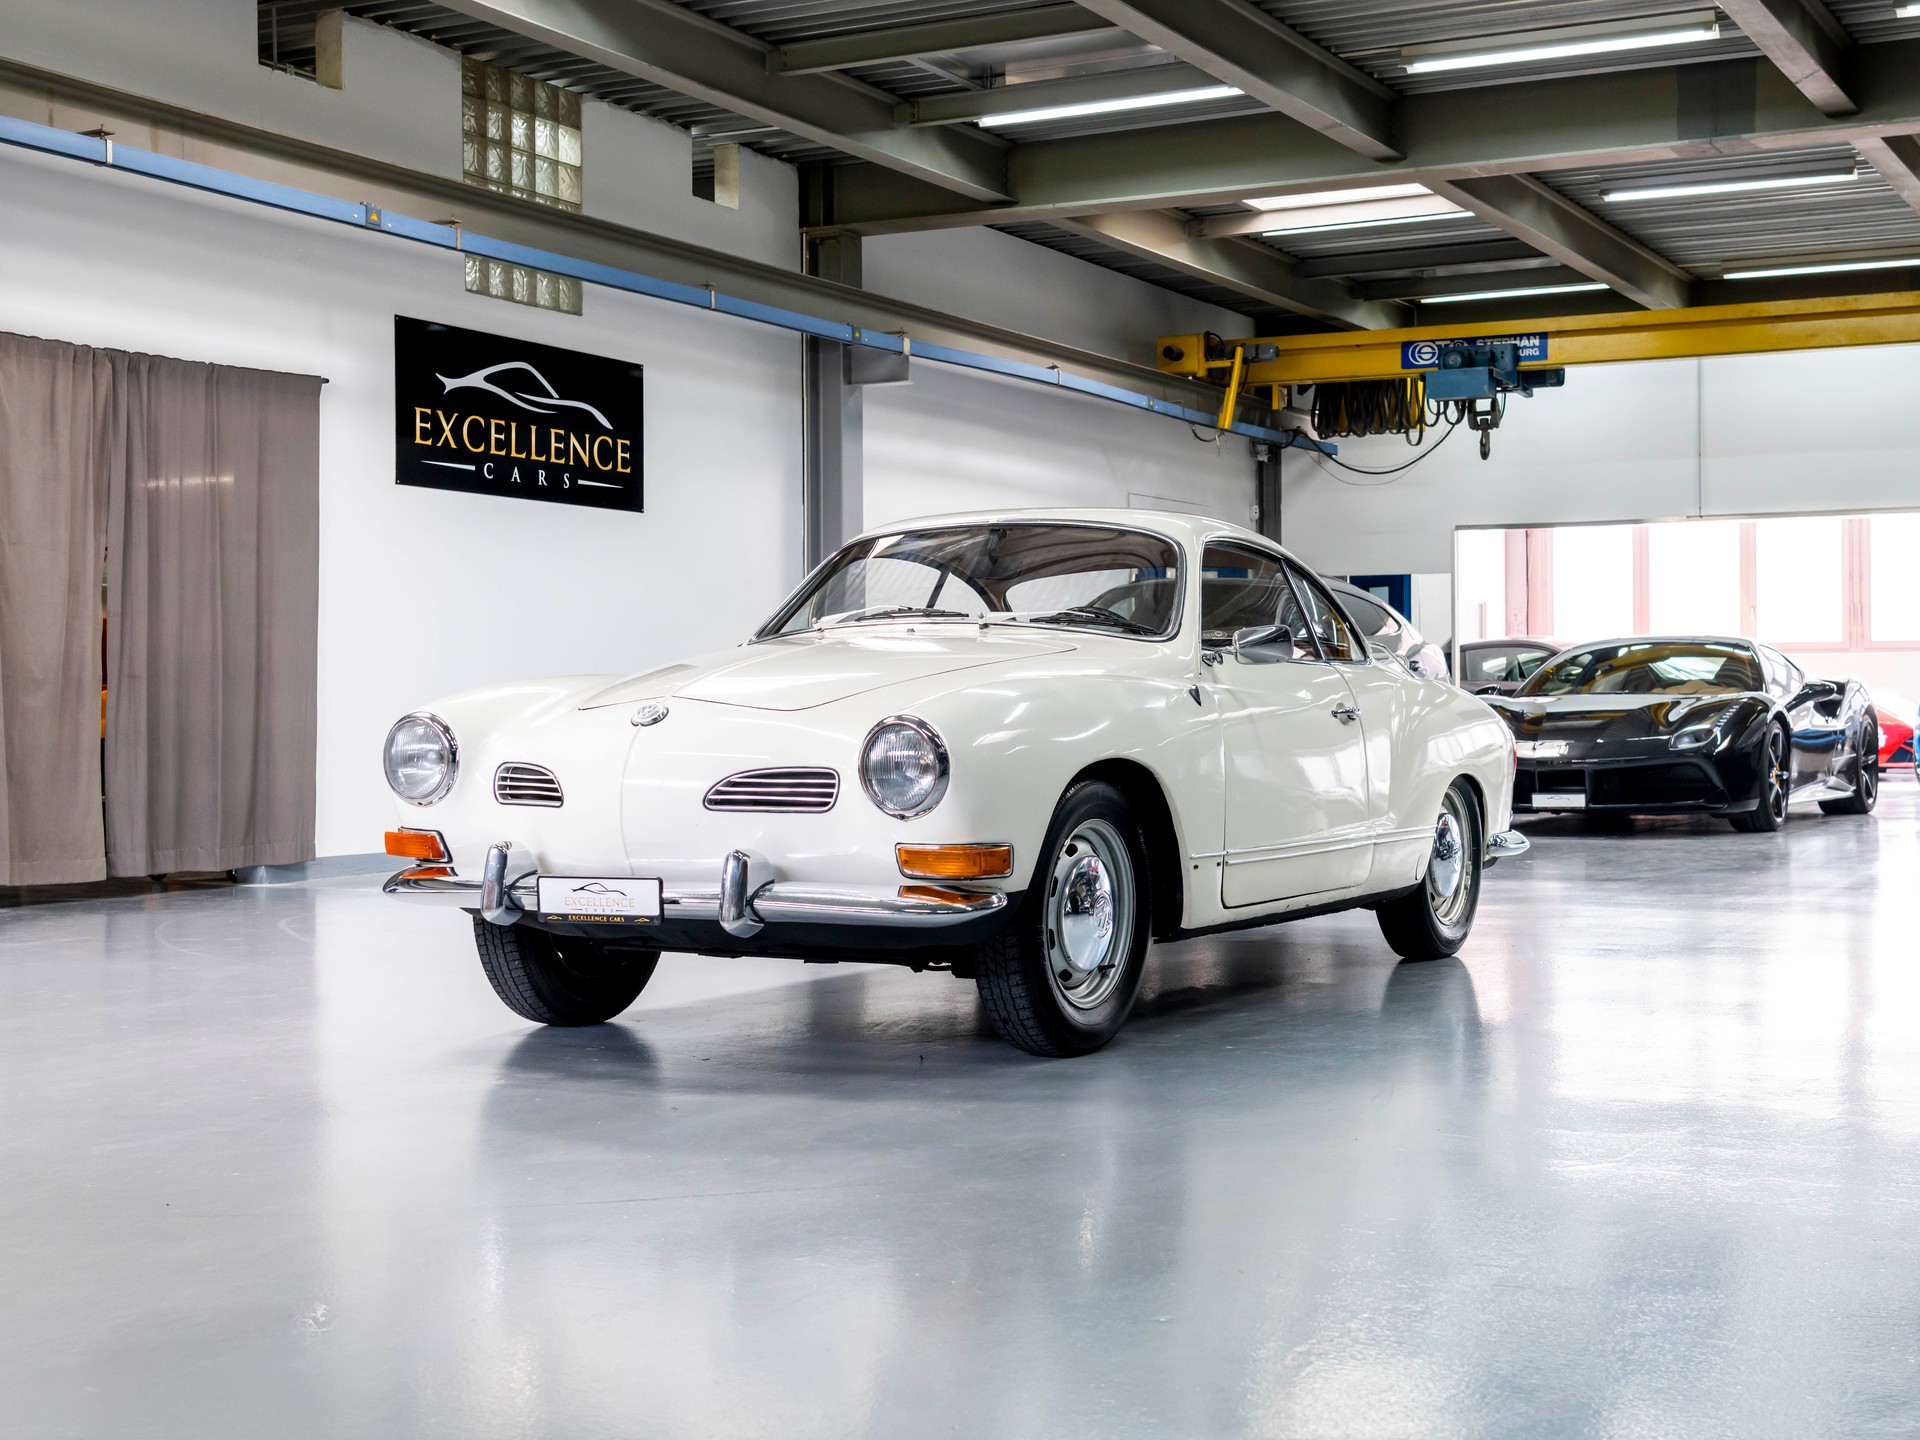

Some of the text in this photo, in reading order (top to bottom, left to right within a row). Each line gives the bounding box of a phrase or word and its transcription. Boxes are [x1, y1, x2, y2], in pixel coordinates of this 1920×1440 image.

[414, 406, 631, 473] EXCELLENCE
[483, 462, 570, 489] CARS
[564, 896, 635, 908] EXCELLENCE
[568, 914, 607, 922] EXCELLENCE
